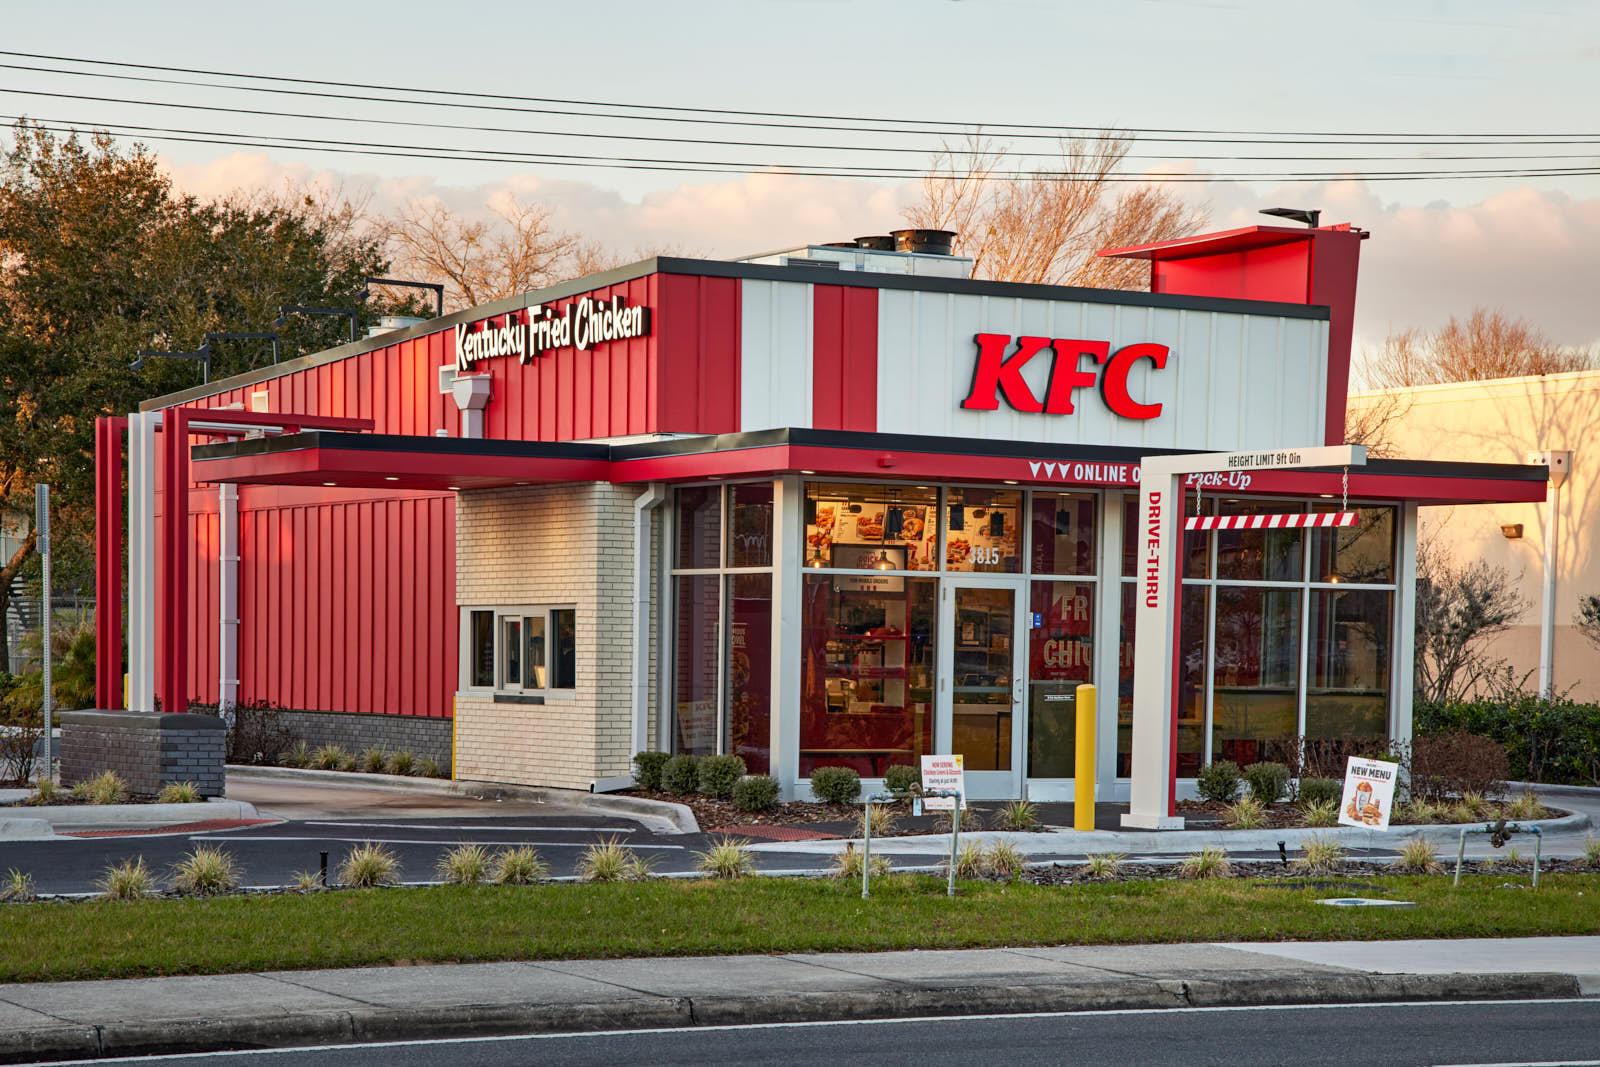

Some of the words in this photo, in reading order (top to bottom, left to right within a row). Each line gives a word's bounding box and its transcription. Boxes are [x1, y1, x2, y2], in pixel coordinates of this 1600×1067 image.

[455, 314, 525, 371] Kentucky
[527, 303, 571, 356] Fried
[574, 295, 643, 351] Chicken
[960, 332, 1170, 420] KFC
[1228, 455, 1254, 468] HEIGHT
[1255, 454, 1275, 466] LIMIT
[1276, 452, 1288, 465] 9ft
[1074, 463, 1127, 483] ONLINE
[968, 546, 1000, 565] 3815
[1145, 491, 1161, 609] DRIVE-THRU
[1350, 766, 1369, 777] NEW
[1368, 768, 1392, 780] MENU
